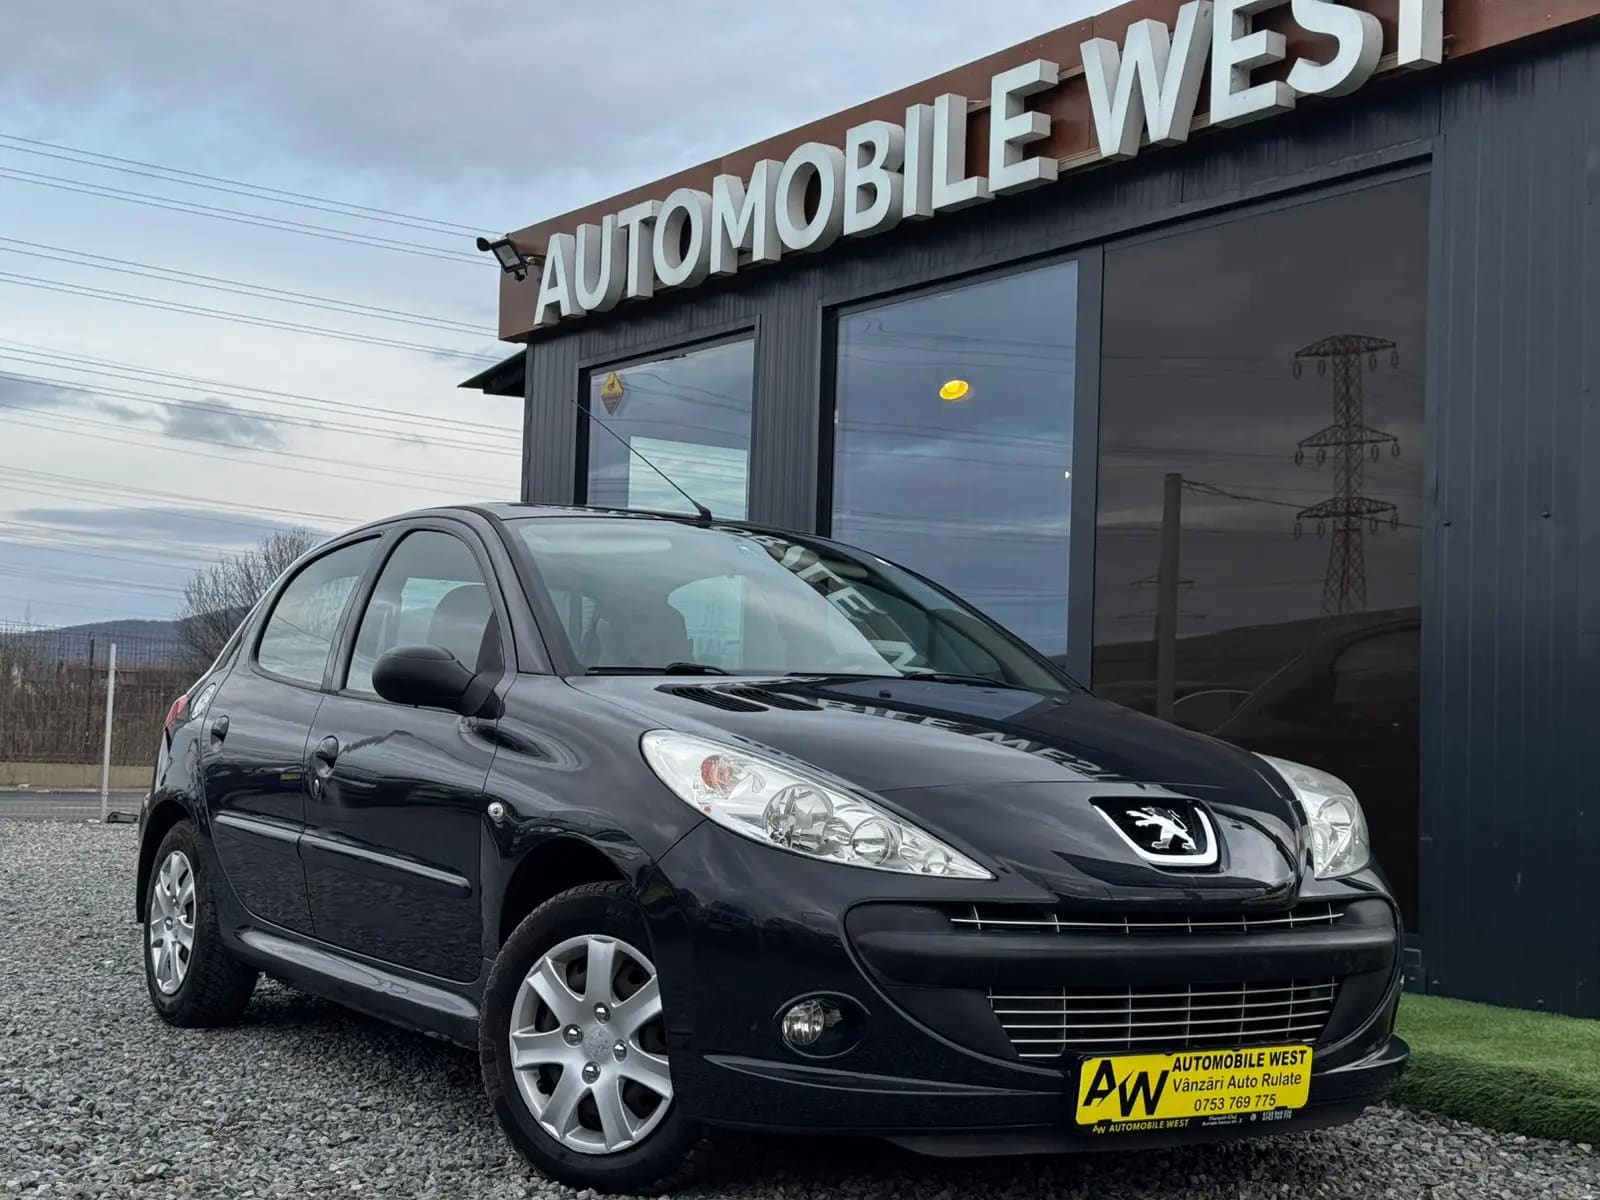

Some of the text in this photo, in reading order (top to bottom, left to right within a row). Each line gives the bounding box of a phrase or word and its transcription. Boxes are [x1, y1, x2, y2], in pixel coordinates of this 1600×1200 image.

[533, 58, 1059, 326] AUTOMOBILE
[1172, 1049, 1307, 1072] AUTOMOBILE WEST
[1082, 1060, 1170, 1117] AW
[1227, 1073, 1259, 1089] Auto
[1262, 1072, 1302, 1086] Rulate
[1194, 1093, 1277, 1112] 0753 769 775
[1109, 1120, 1165, 1133] AUTOMOBILE
[1166, 1118, 1189, 1129] WEST
